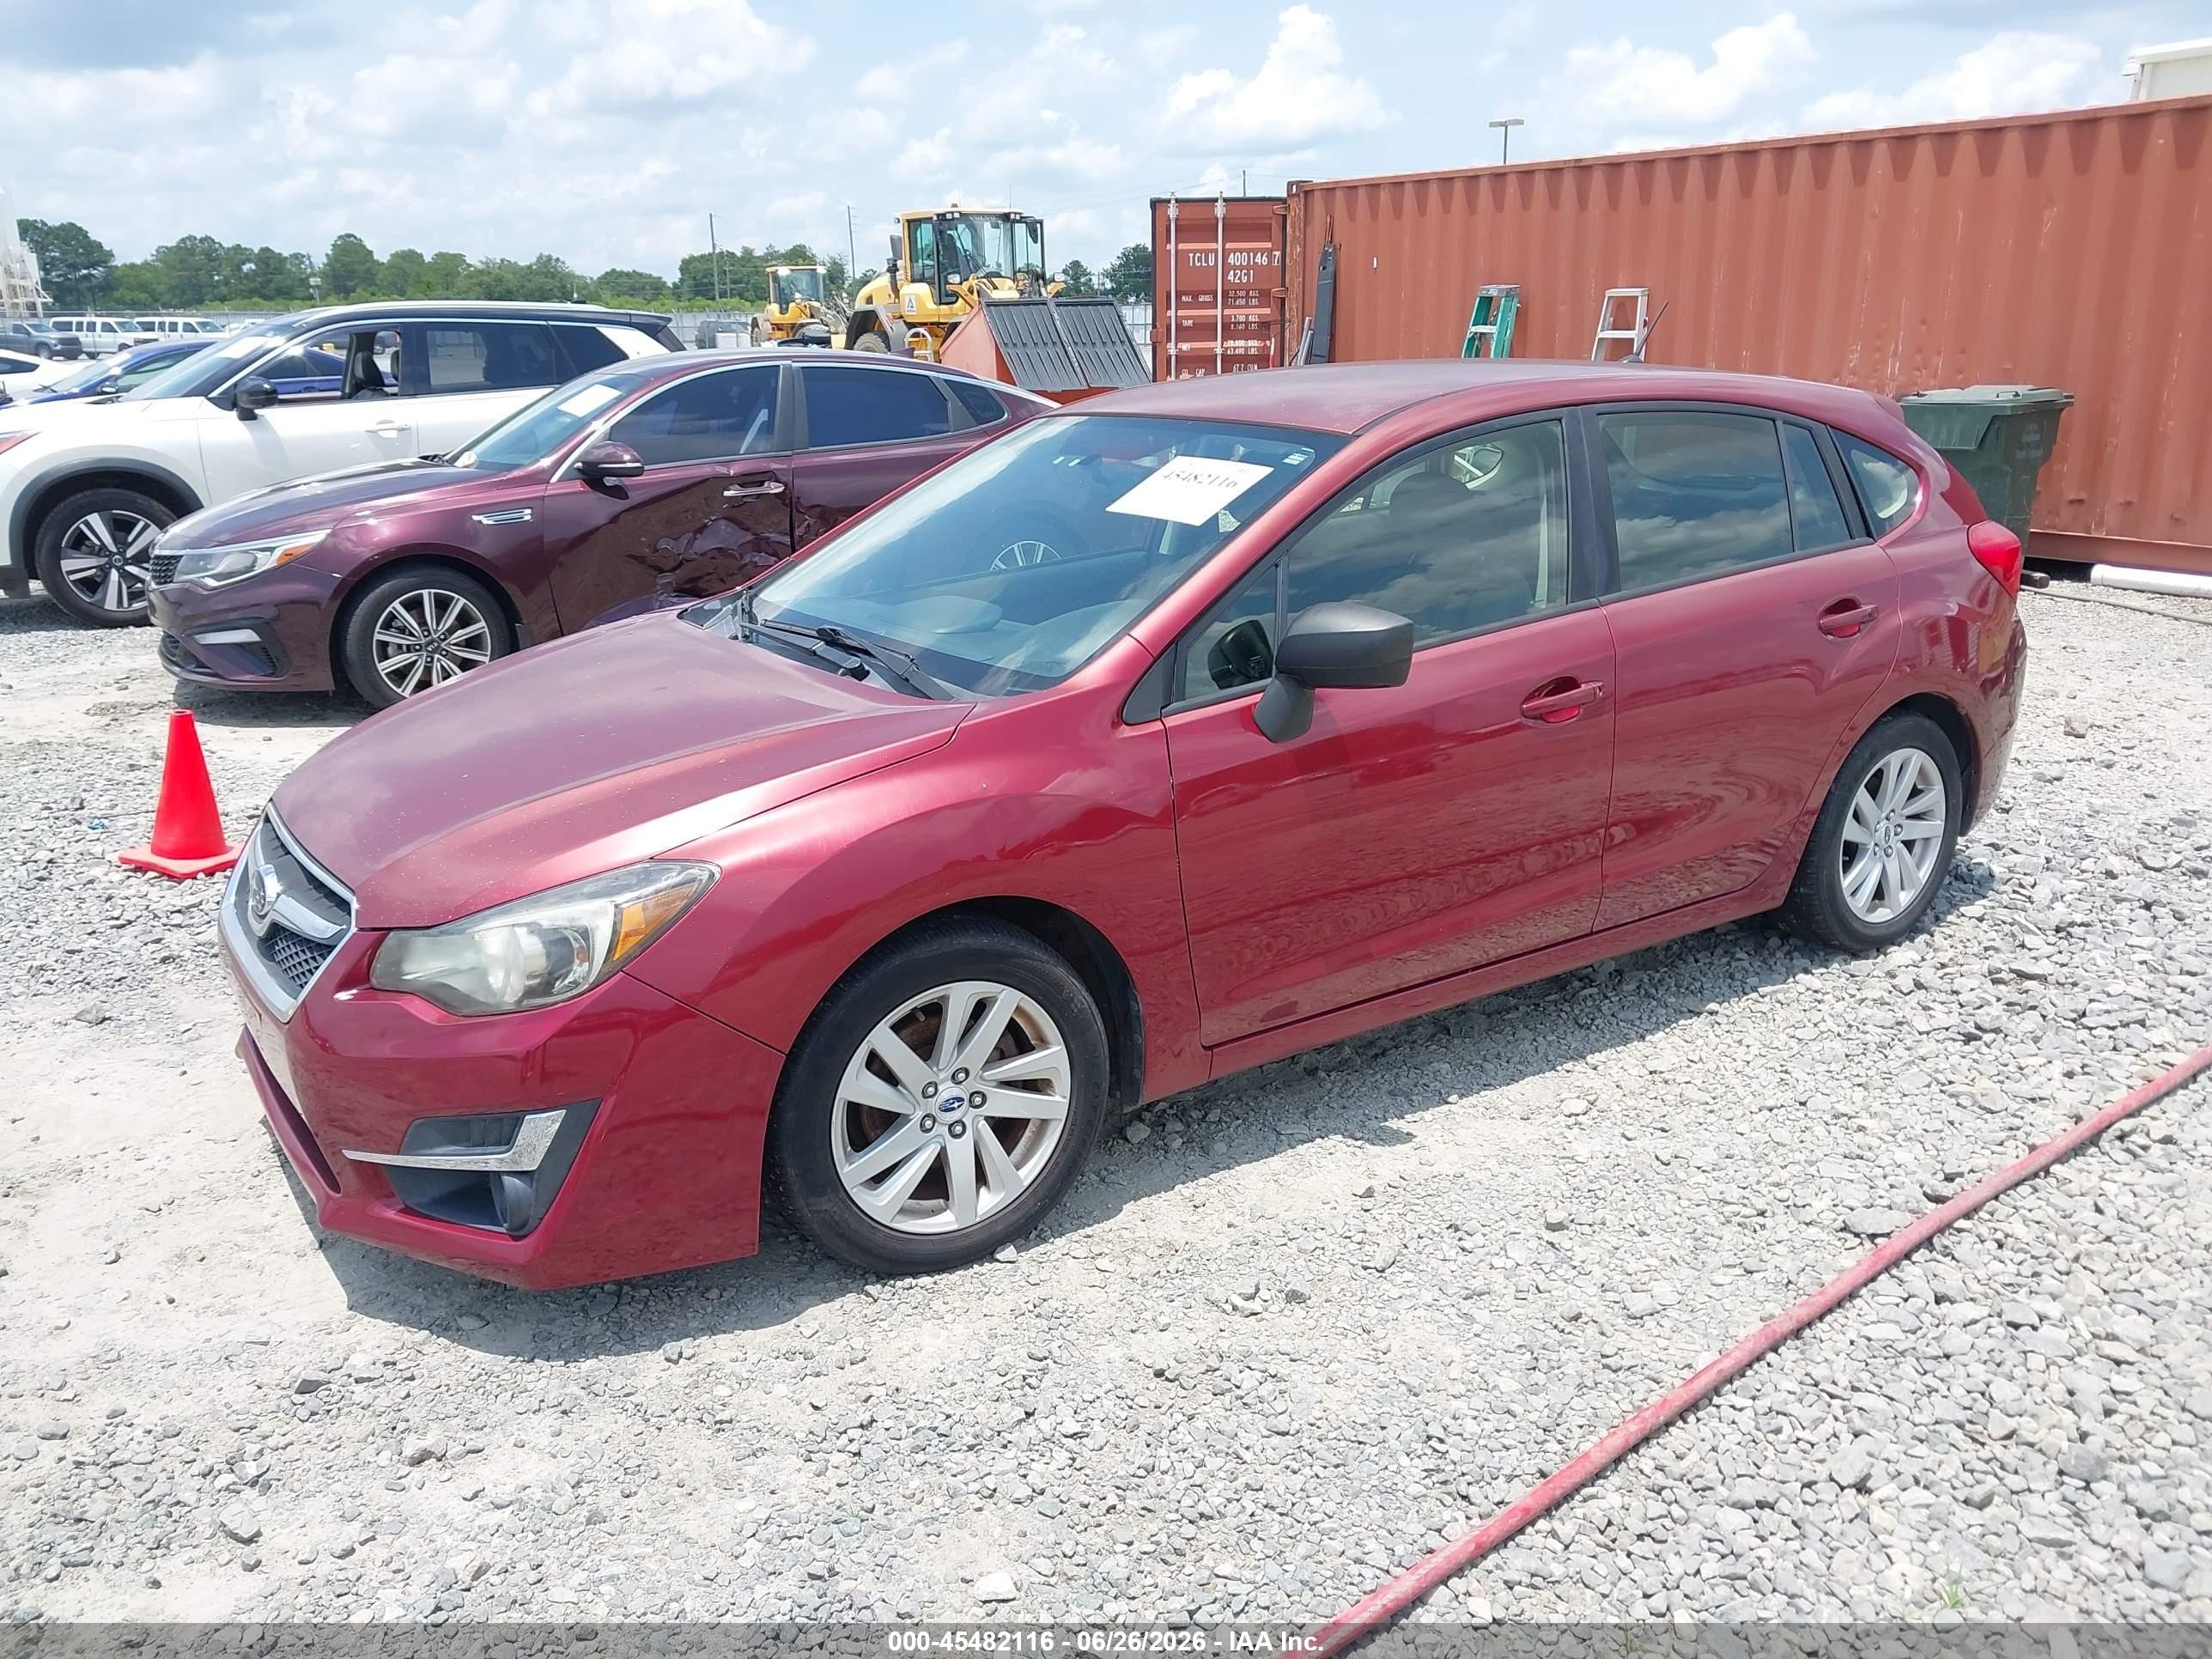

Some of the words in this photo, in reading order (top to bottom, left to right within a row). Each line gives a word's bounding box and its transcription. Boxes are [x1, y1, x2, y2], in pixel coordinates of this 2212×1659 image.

[1188, 252, 1215, 267] TCLU
[1227, 252, 1268, 266] 400146
[1273, 252, 1280, 266] 7
[1227, 270, 1254, 283] 42G1
